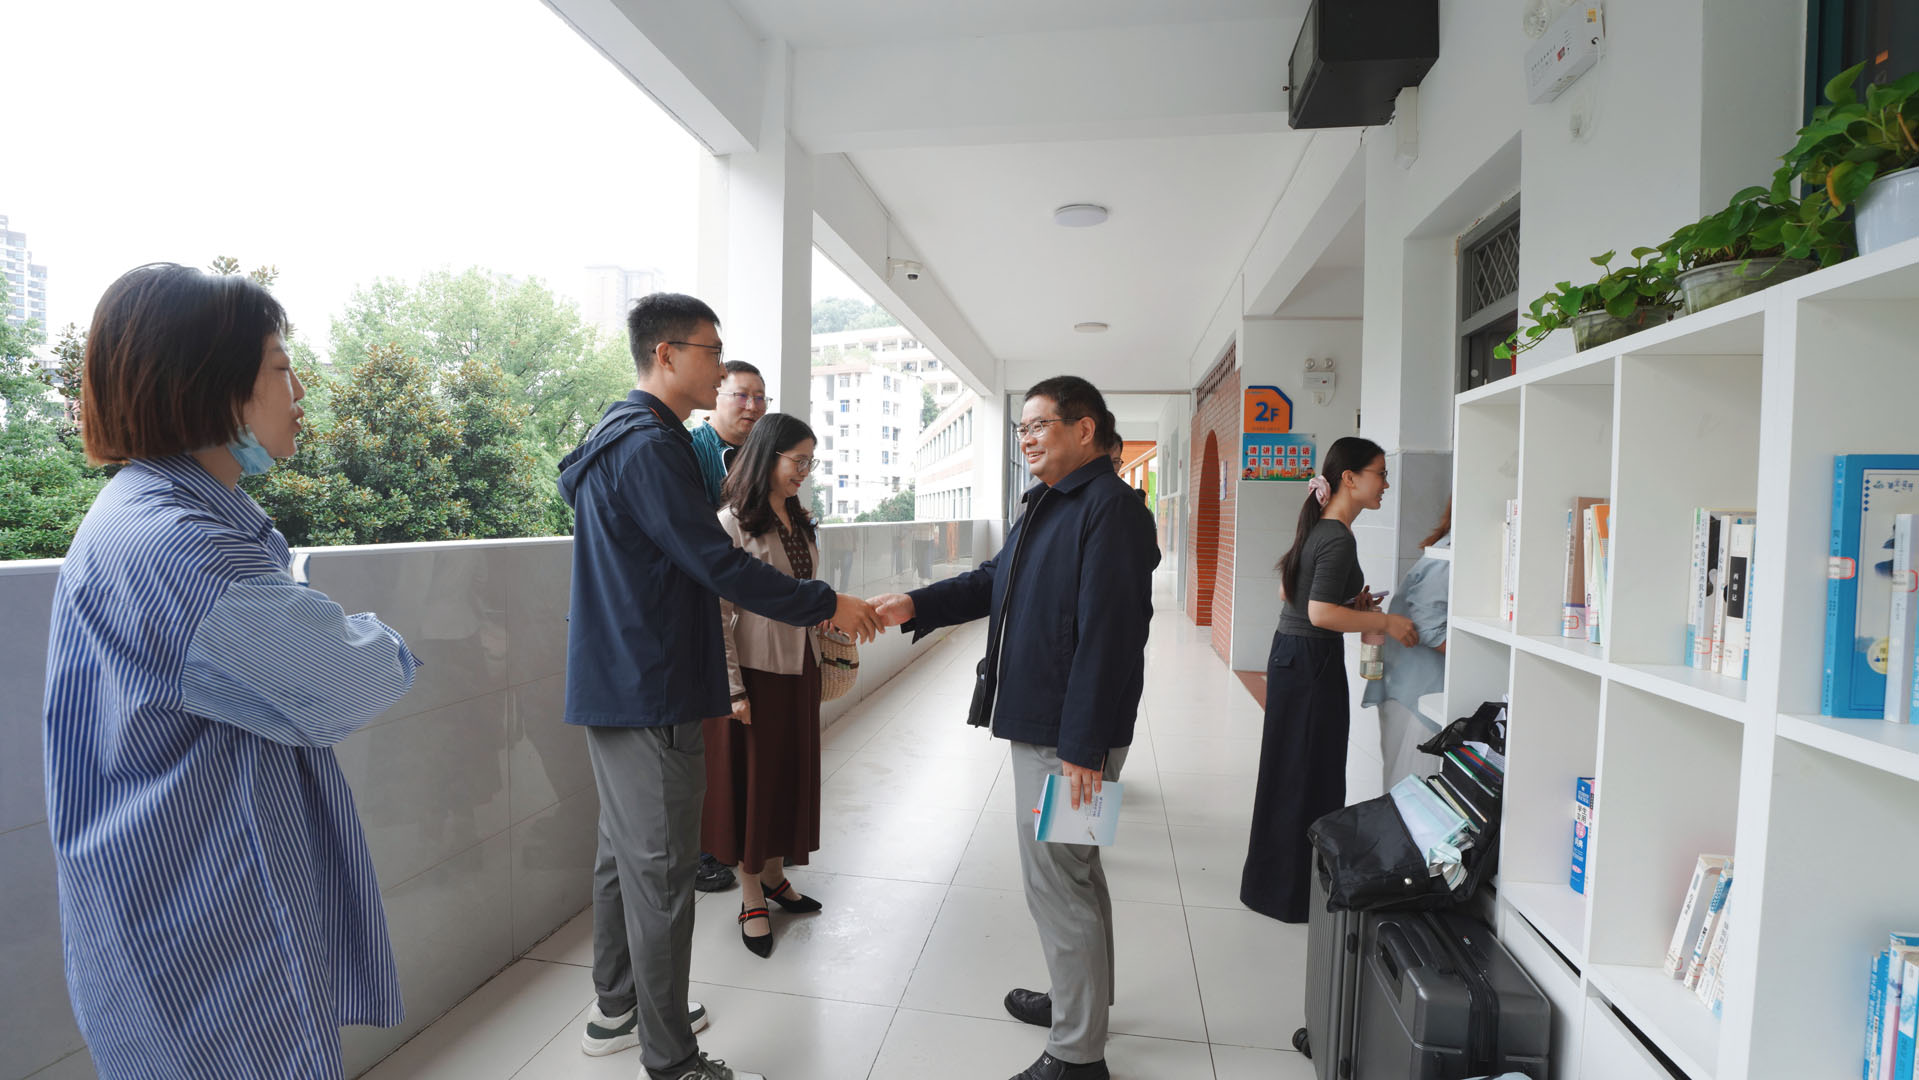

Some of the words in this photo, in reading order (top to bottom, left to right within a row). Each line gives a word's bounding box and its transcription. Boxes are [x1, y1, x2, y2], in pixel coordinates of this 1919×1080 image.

[1255, 401, 1280, 422] 2F
[1249, 446, 1310, 455] 请讲普通话
[1249, 458, 1310, 467] 请写规范字
